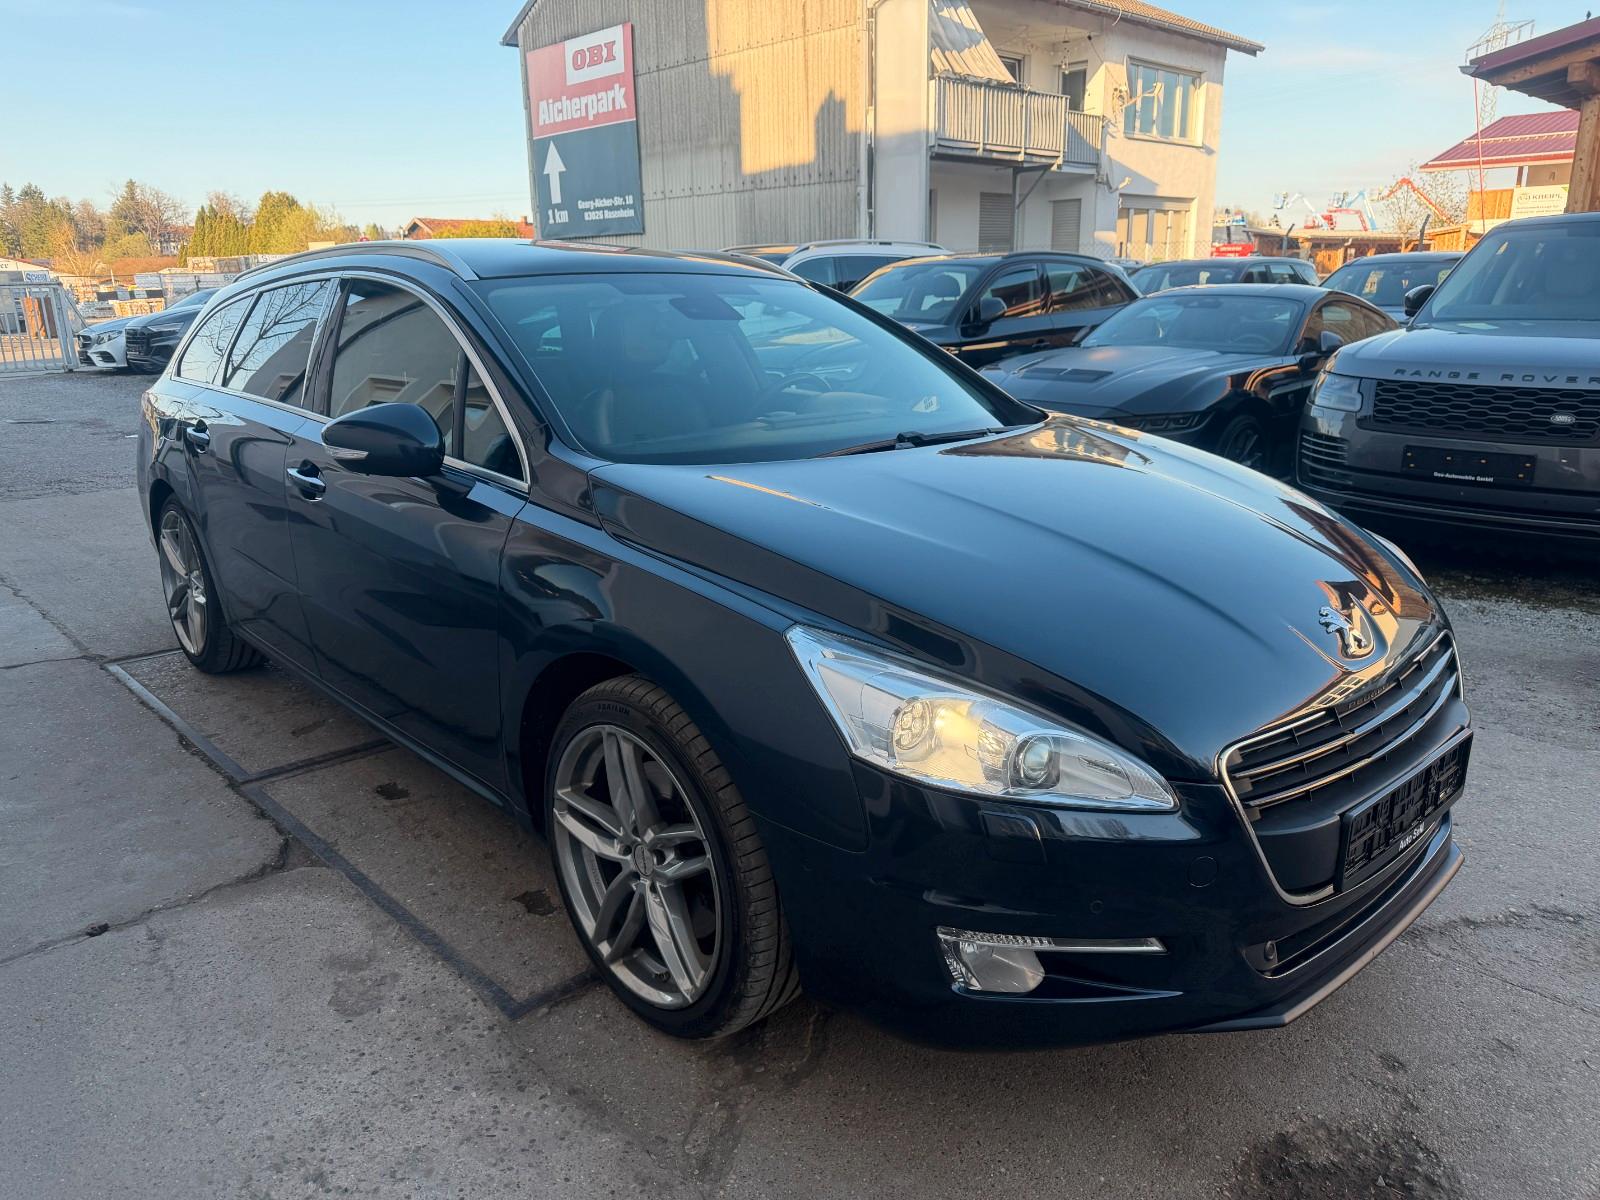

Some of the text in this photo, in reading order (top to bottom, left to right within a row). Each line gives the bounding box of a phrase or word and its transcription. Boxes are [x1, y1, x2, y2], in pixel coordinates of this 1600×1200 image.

[572, 41, 616, 70] OBI
[539, 84, 626, 125] Aicherpark
[554, 208, 569, 224] km
[1393, 368, 1600, 385] RANGE ROVER
[1399, 835, 1412, 852] Auto
